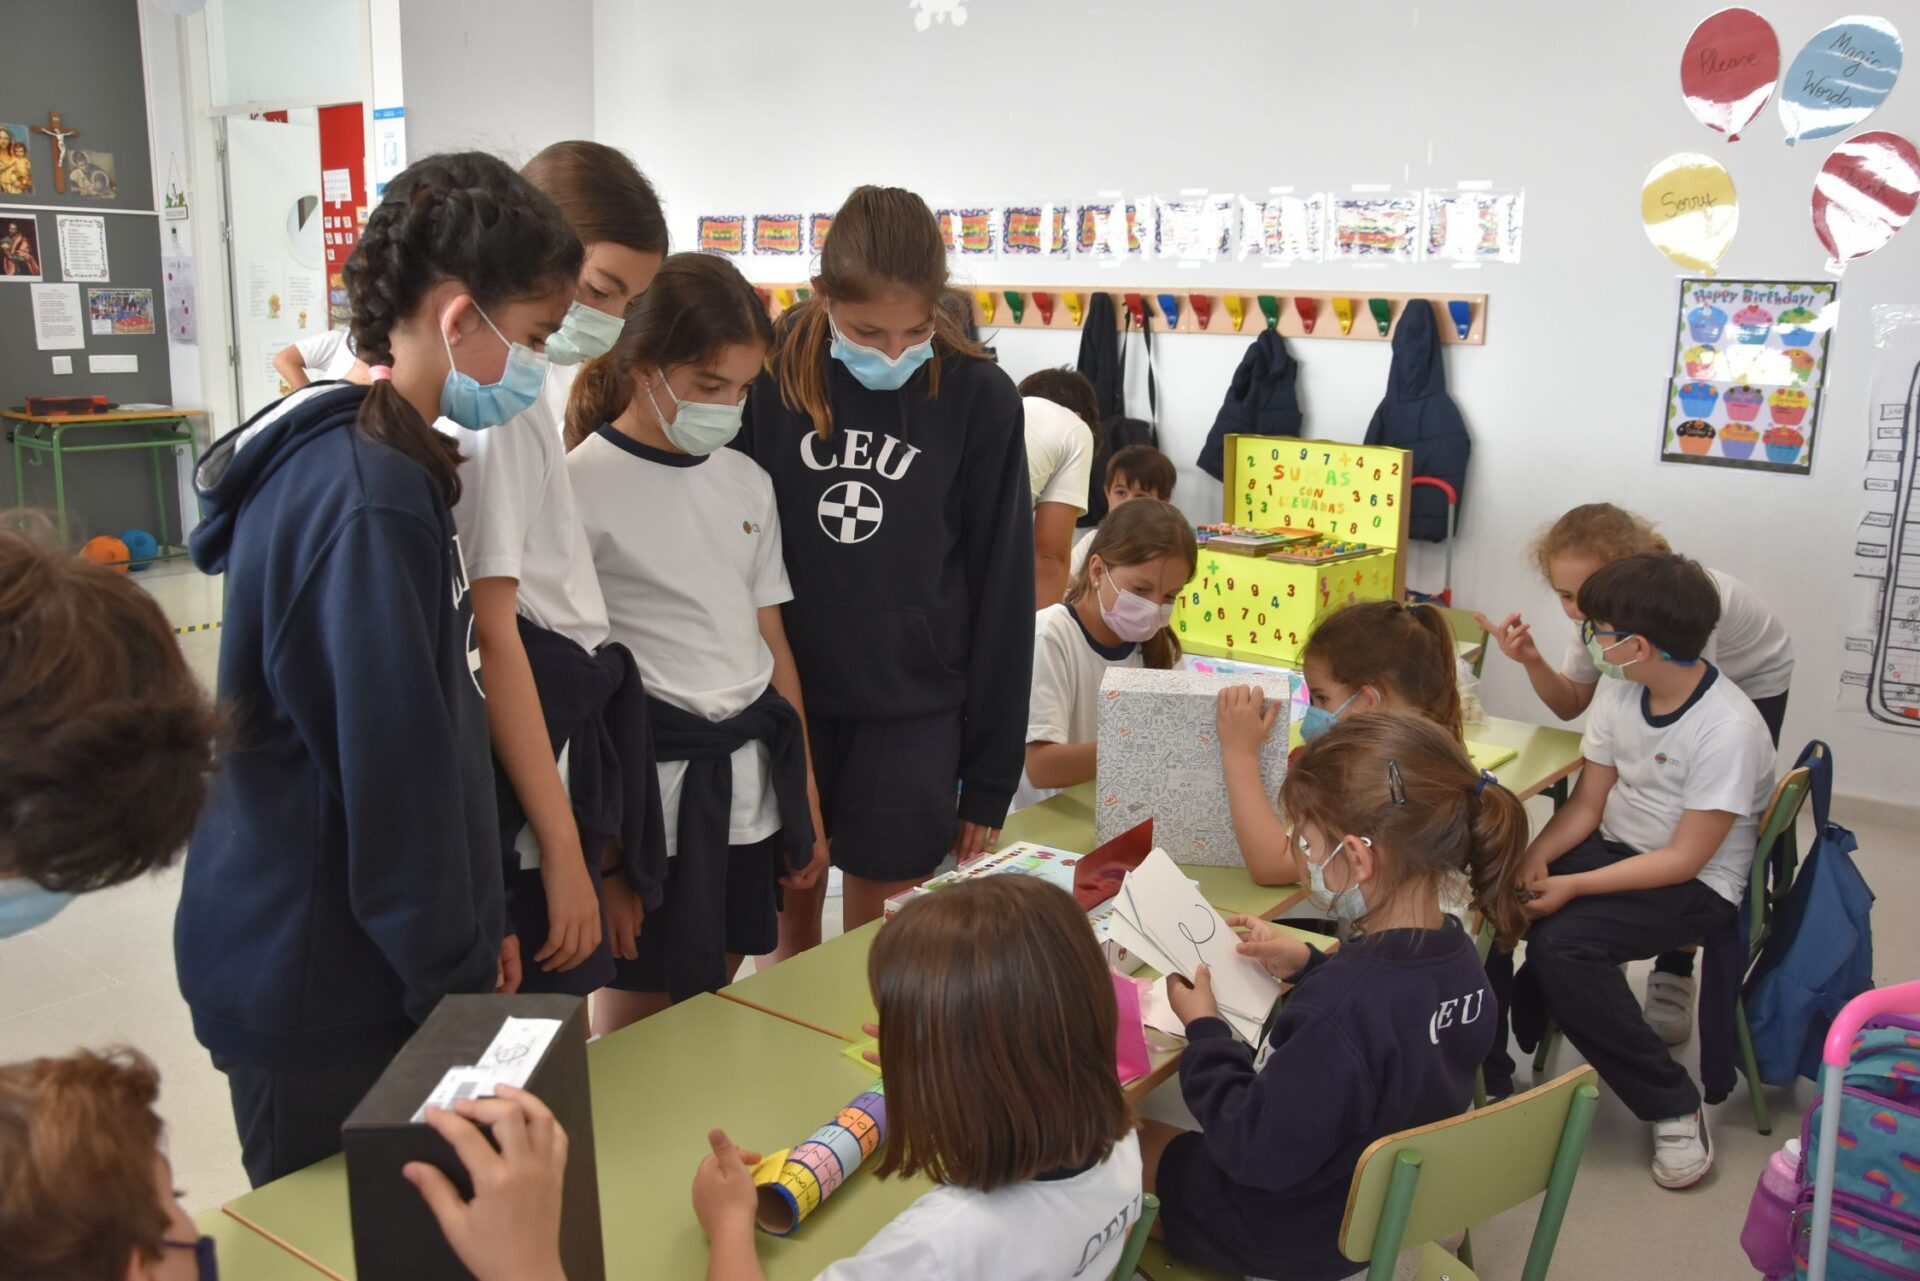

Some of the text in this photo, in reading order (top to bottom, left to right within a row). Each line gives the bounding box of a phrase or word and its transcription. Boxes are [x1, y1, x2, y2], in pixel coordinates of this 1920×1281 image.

[1700, 48, 1760, 76] Please
[1829, 32, 1884, 77] Magic
[1802, 70, 1853, 107] Words
[1660, 191, 1718, 220] Sorry
[1694, 288, 1815, 307] Happy Birthday!
[800, 428, 922, 481] CEU
[1273, 464, 1351, 486] SUAS
[1278, 496, 1345, 514] LEVADAS
[1299, 486, 1325, 499] CON
